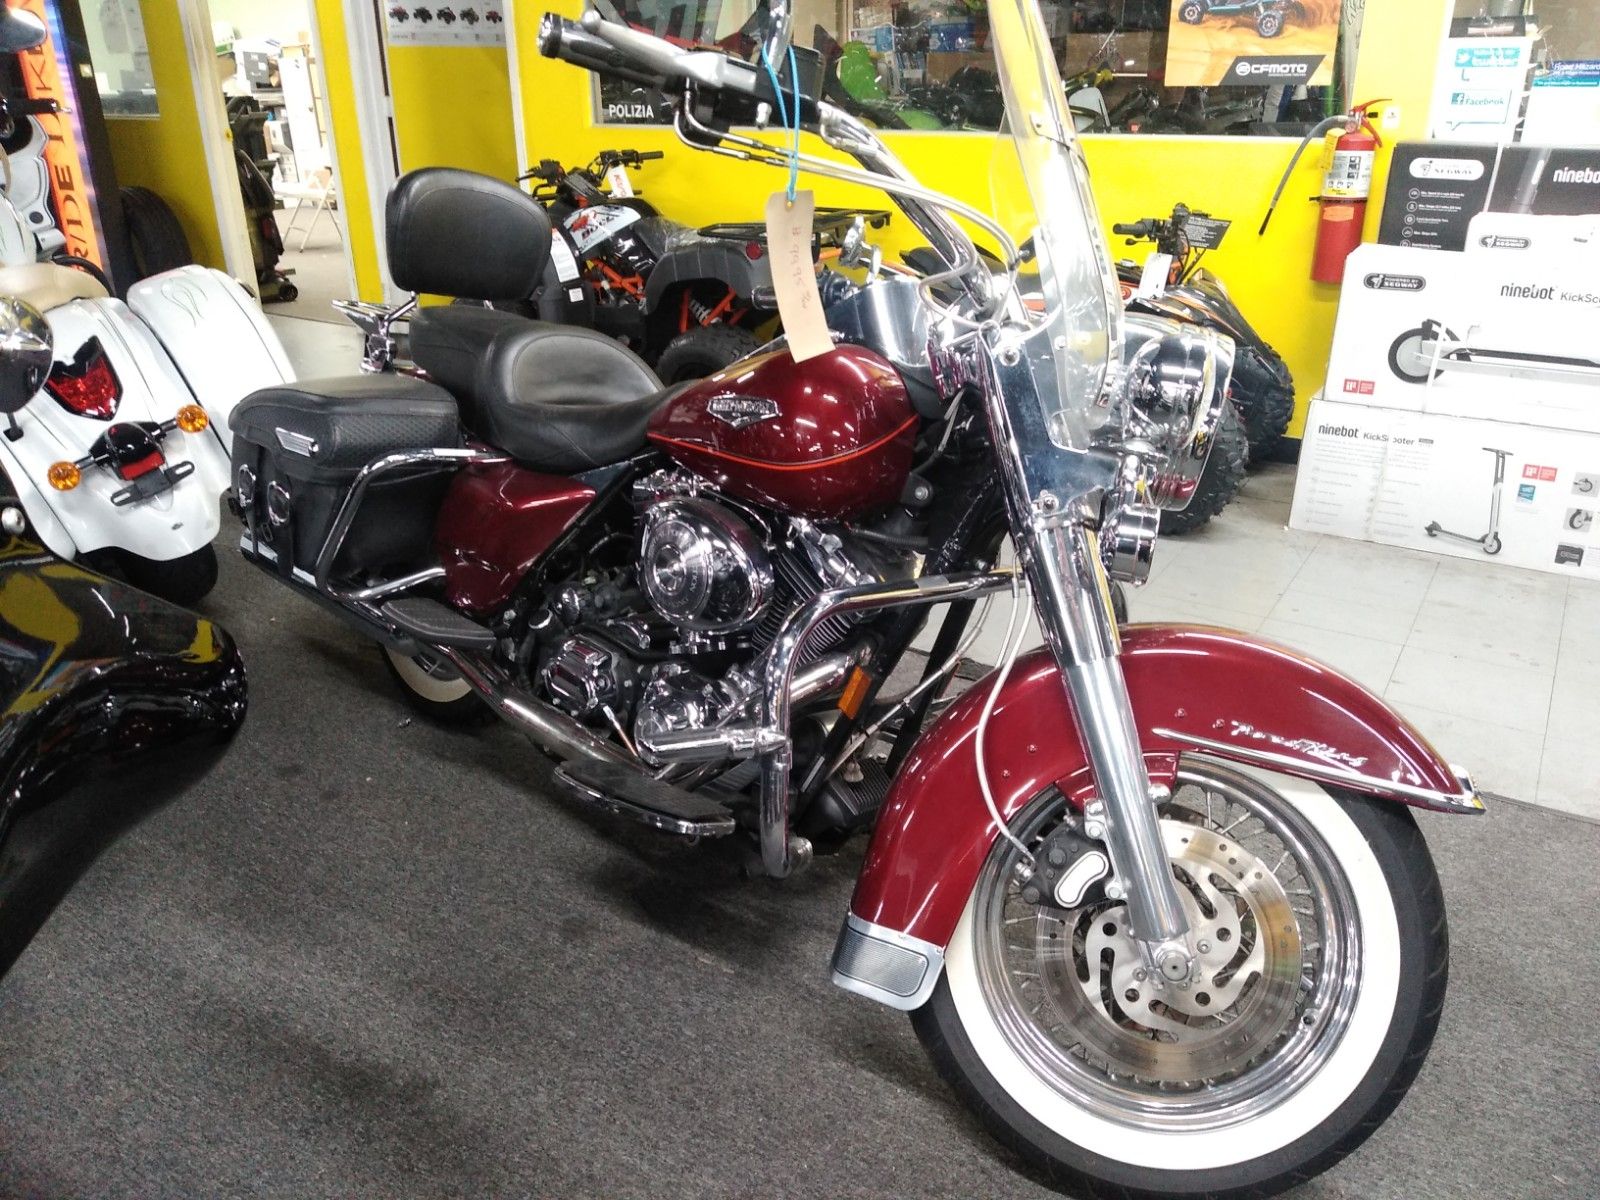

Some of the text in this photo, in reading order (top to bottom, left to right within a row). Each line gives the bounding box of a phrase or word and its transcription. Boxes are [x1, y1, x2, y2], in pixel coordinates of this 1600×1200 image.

[1251, 63, 1308, 74] CFMOTO
[608, 103, 655, 119] POLIZIA
[1383, 281, 1419, 289] SEGWAY
[1500, 282, 1556, 301] ninebot
[1318, 424, 1360, 439] ninebot
